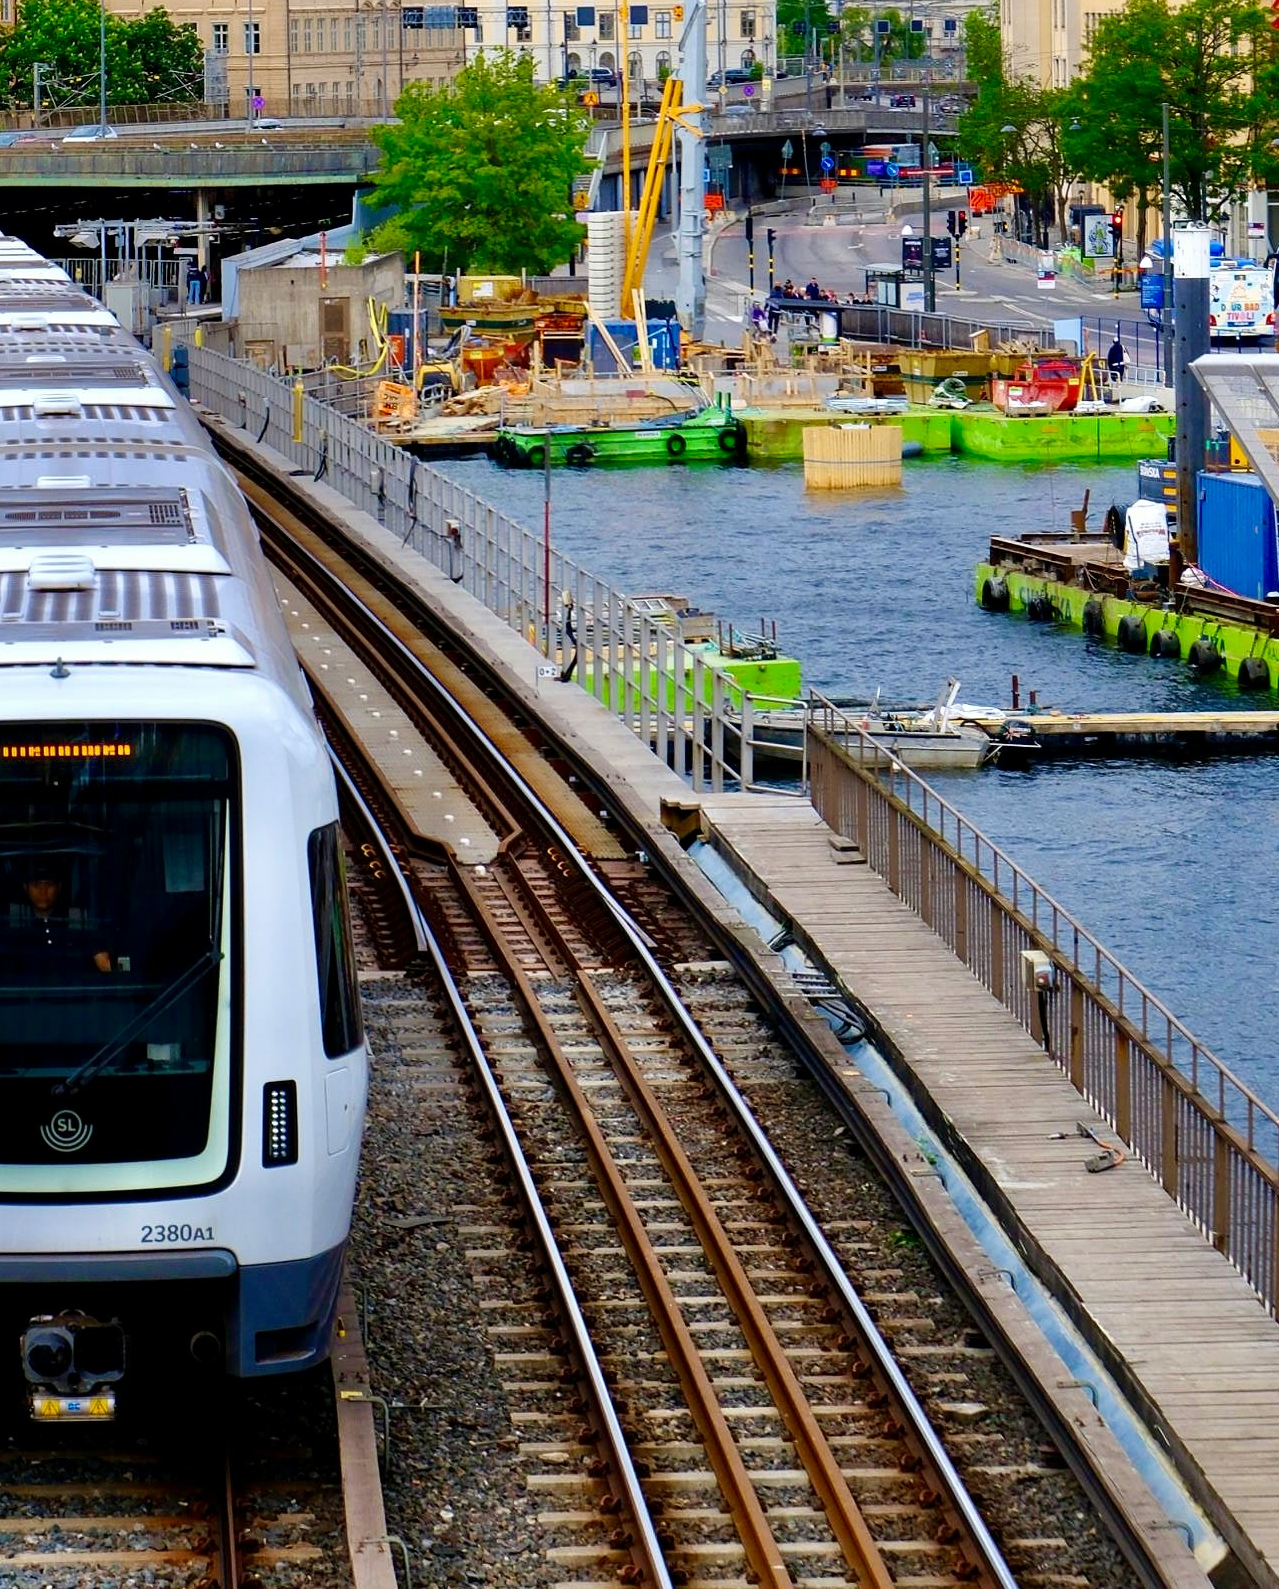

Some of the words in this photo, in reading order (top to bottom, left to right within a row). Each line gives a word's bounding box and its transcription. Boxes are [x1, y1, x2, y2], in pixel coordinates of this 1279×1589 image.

[1227, 311, 1255, 320] TIVOLI
[57, 1118, 76, 1132] SL
[140, 1224, 215, 1243] 2380A1
